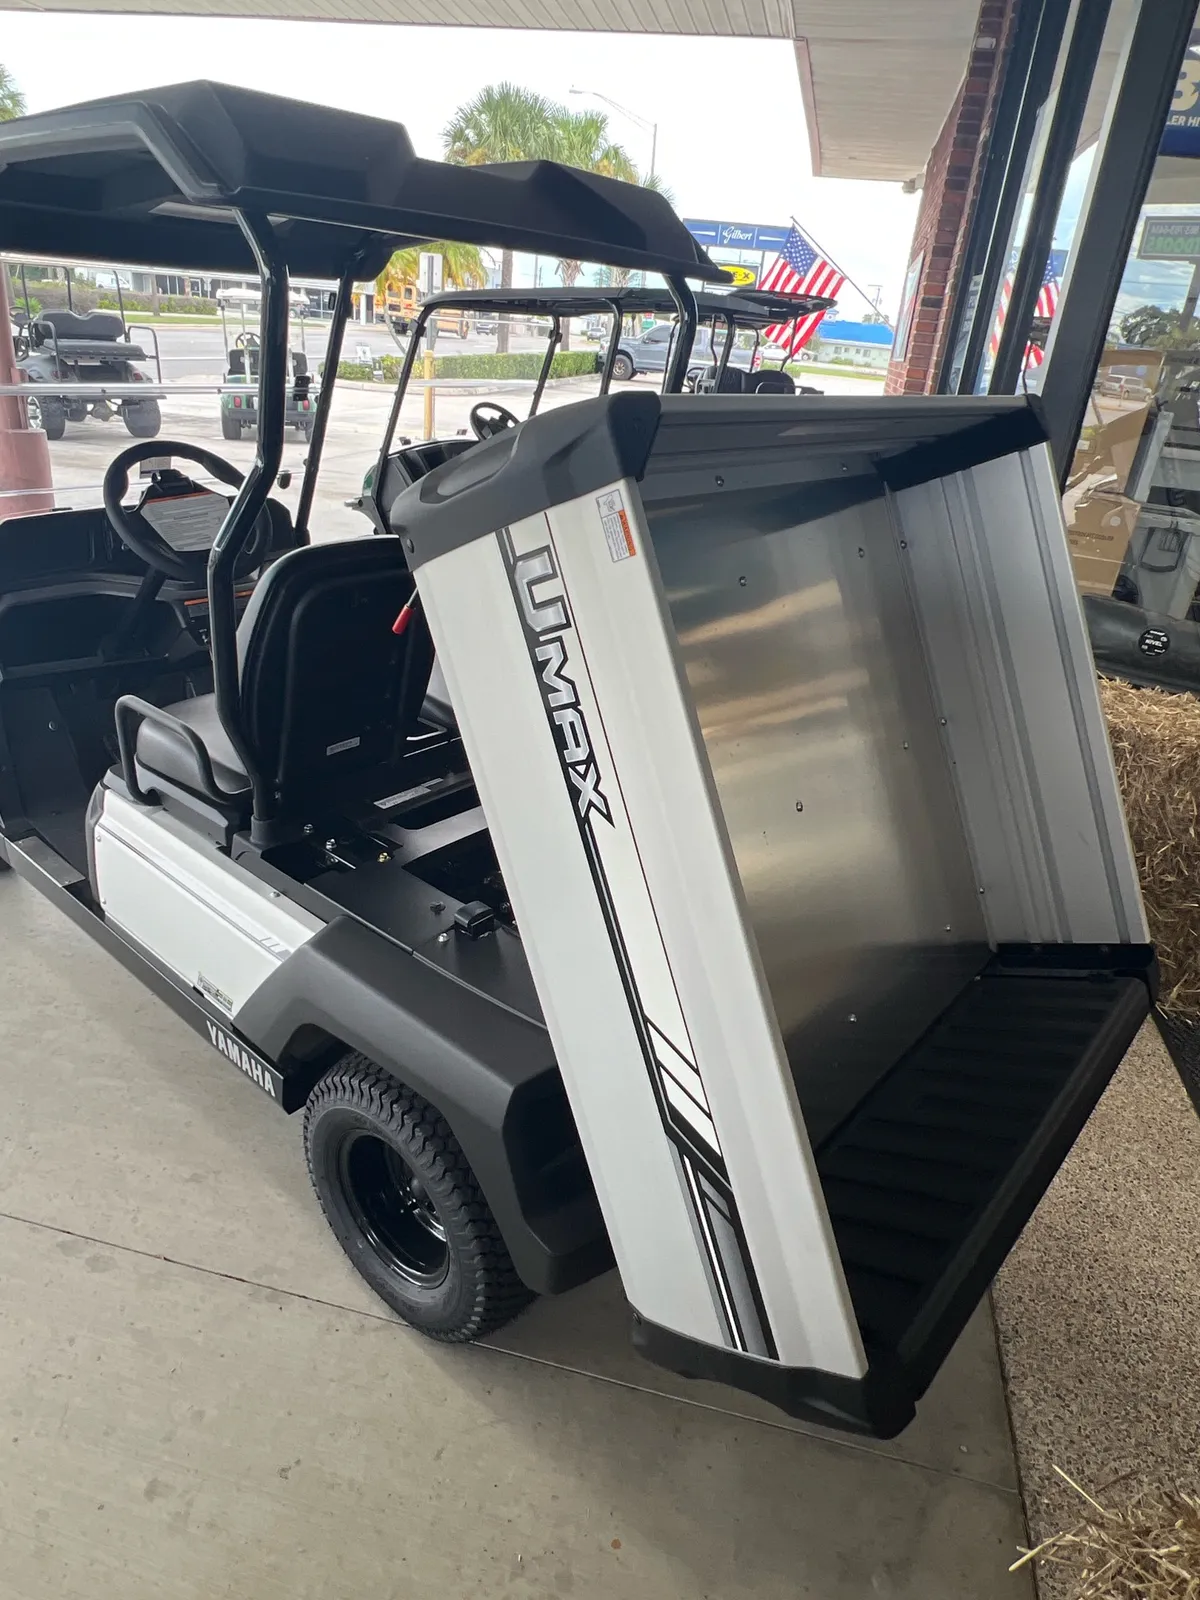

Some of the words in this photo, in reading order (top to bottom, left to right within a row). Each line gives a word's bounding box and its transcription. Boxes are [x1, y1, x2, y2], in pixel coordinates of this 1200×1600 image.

[722, 226, 753, 244] Gilbert
[510, 547, 612, 824] UMAX
[206, 1020, 276, 1098] YAMAHA
